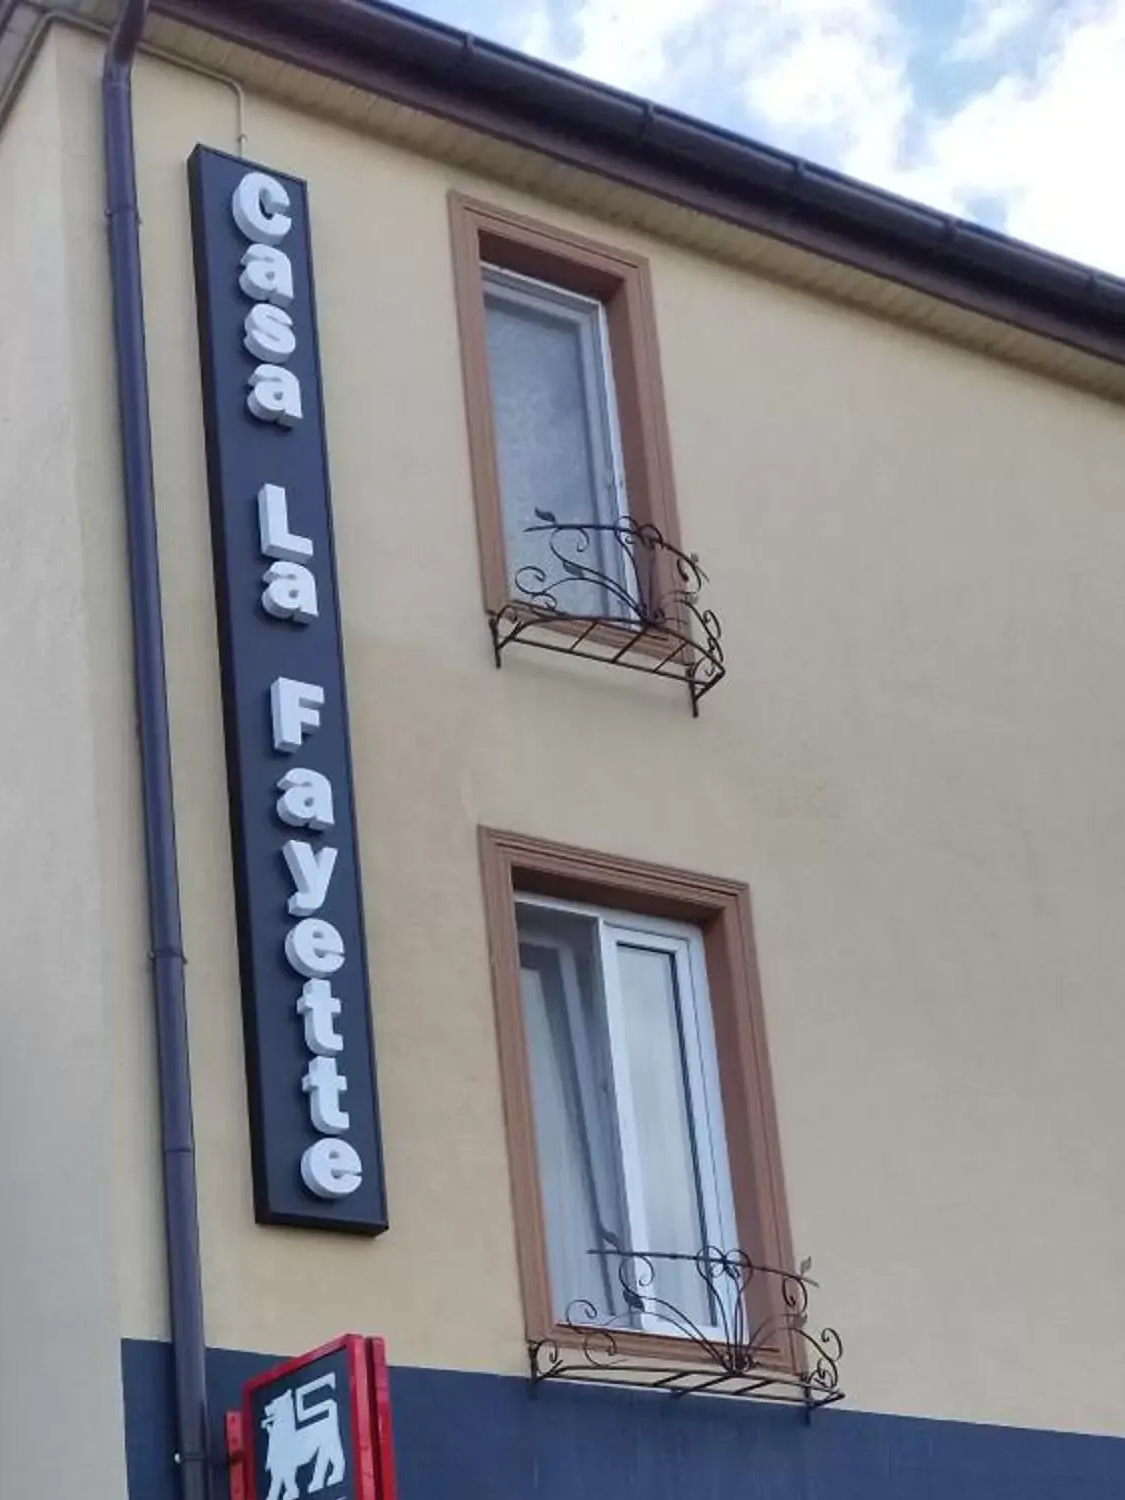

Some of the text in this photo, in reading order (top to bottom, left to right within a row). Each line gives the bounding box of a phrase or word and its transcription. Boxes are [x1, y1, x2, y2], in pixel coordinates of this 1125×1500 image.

[232, 171, 363, 1200] Casa La Fayette
